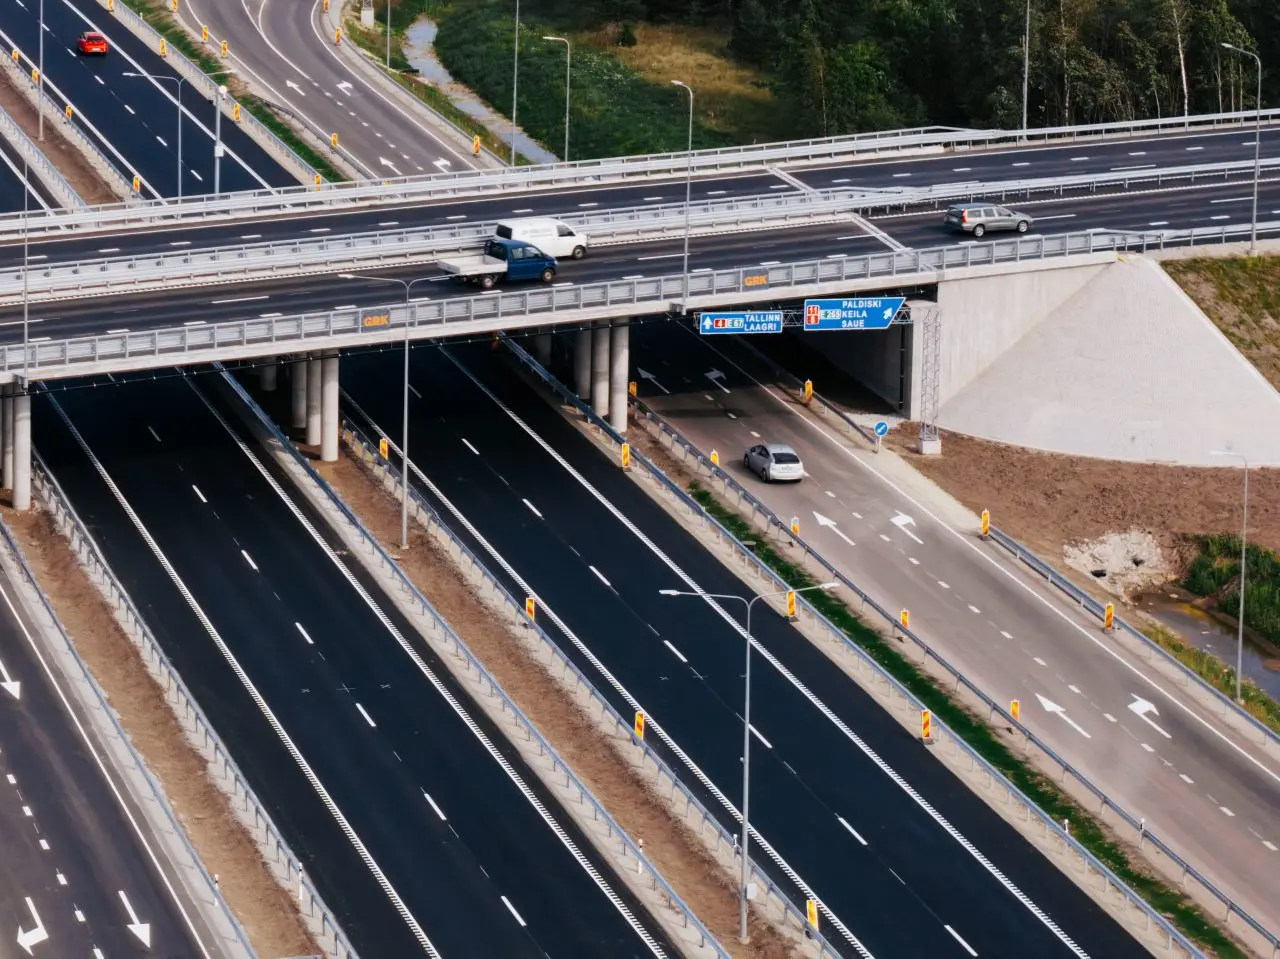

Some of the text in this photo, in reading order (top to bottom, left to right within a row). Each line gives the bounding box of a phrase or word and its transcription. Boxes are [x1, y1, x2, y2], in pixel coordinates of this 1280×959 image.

[744, 275, 768, 286] GRK
[842, 301, 881, 309] PALDISKI
[744, 314, 780, 322] TALLINN
[841, 310, 867, 318] KEILA
[364, 315, 388, 327] GRK
[841, 320, 865, 328] SAUE
[744, 323, 776, 331] LAAGRI
